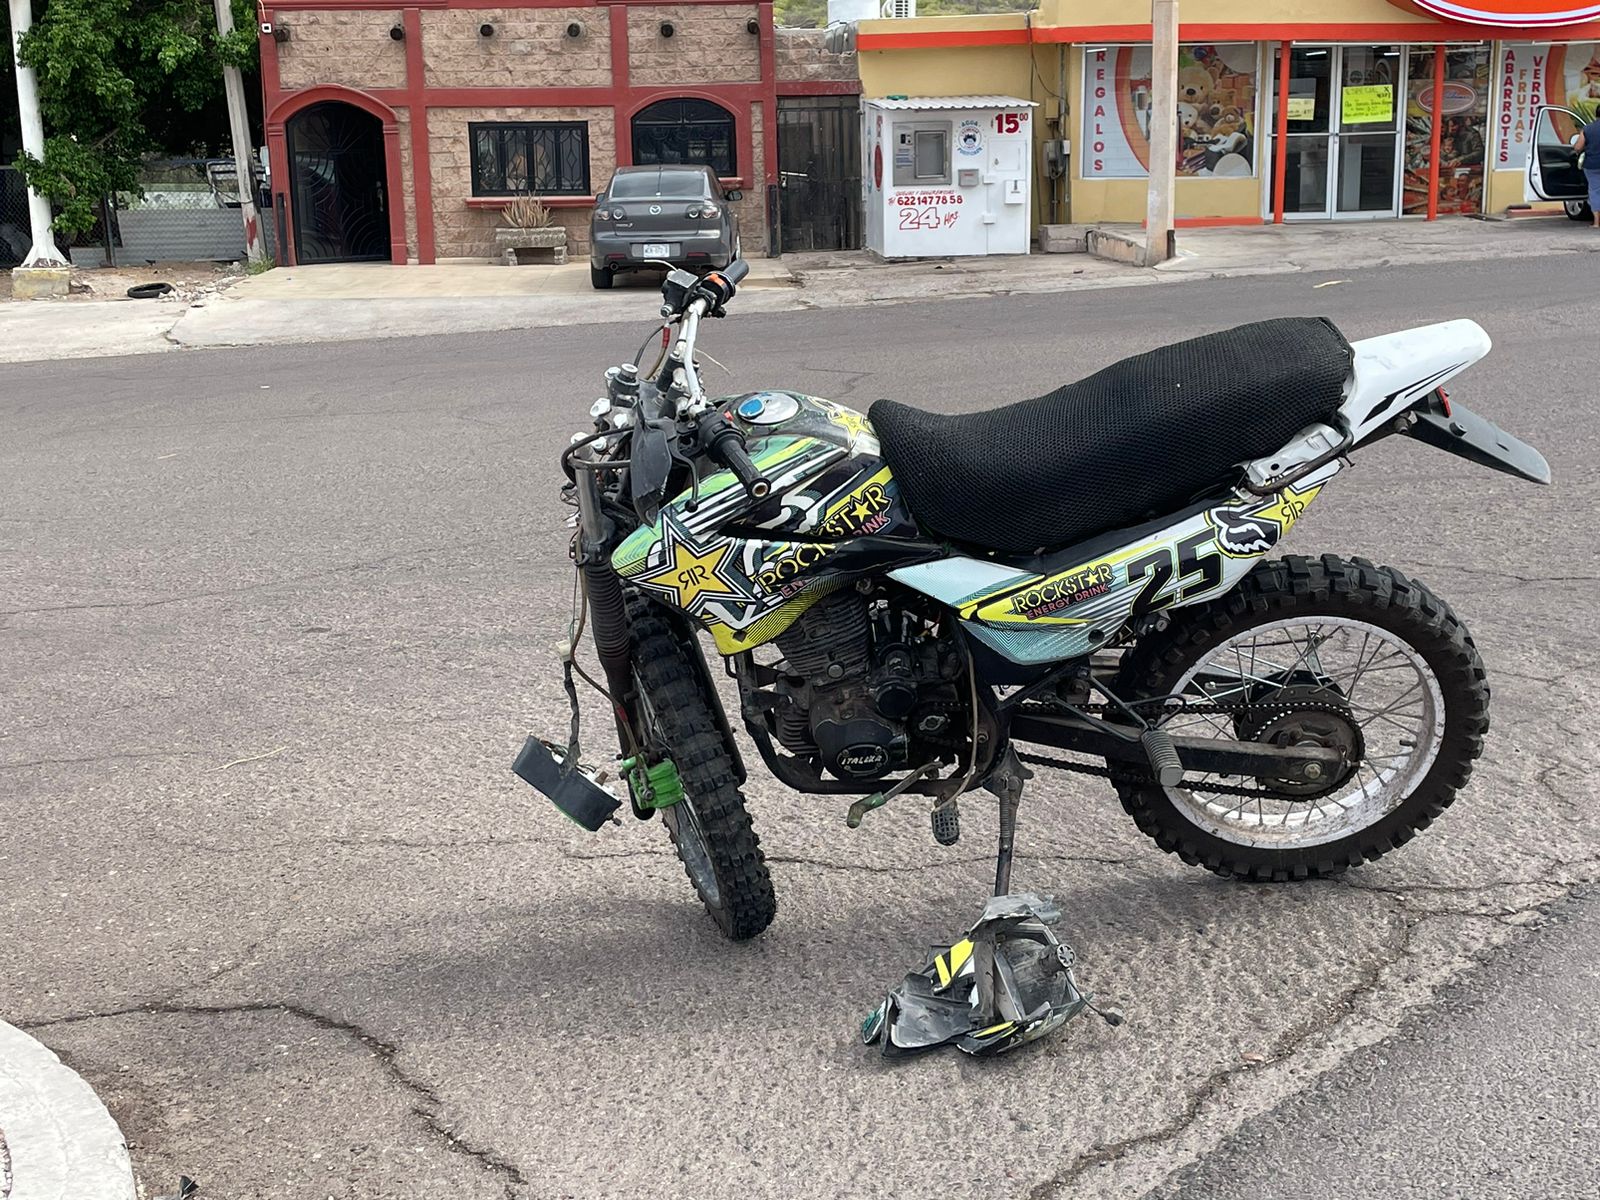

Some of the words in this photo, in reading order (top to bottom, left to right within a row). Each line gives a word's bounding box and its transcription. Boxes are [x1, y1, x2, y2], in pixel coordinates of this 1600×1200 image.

[1093, 51, 1106, 171] REGALOS
[1500, 50, 1515, 162] ABARROTES
[1515, 69, 1527, 143] FRUTAS
[1528, 56, 1543, 143] VERDU
[899, 207, 940, 230] 24
[1027, 597, 1070, 618] ENERGY
[1075, 583, 1108, 602] DRINK
[1126, 525, 1223, 616] 25
